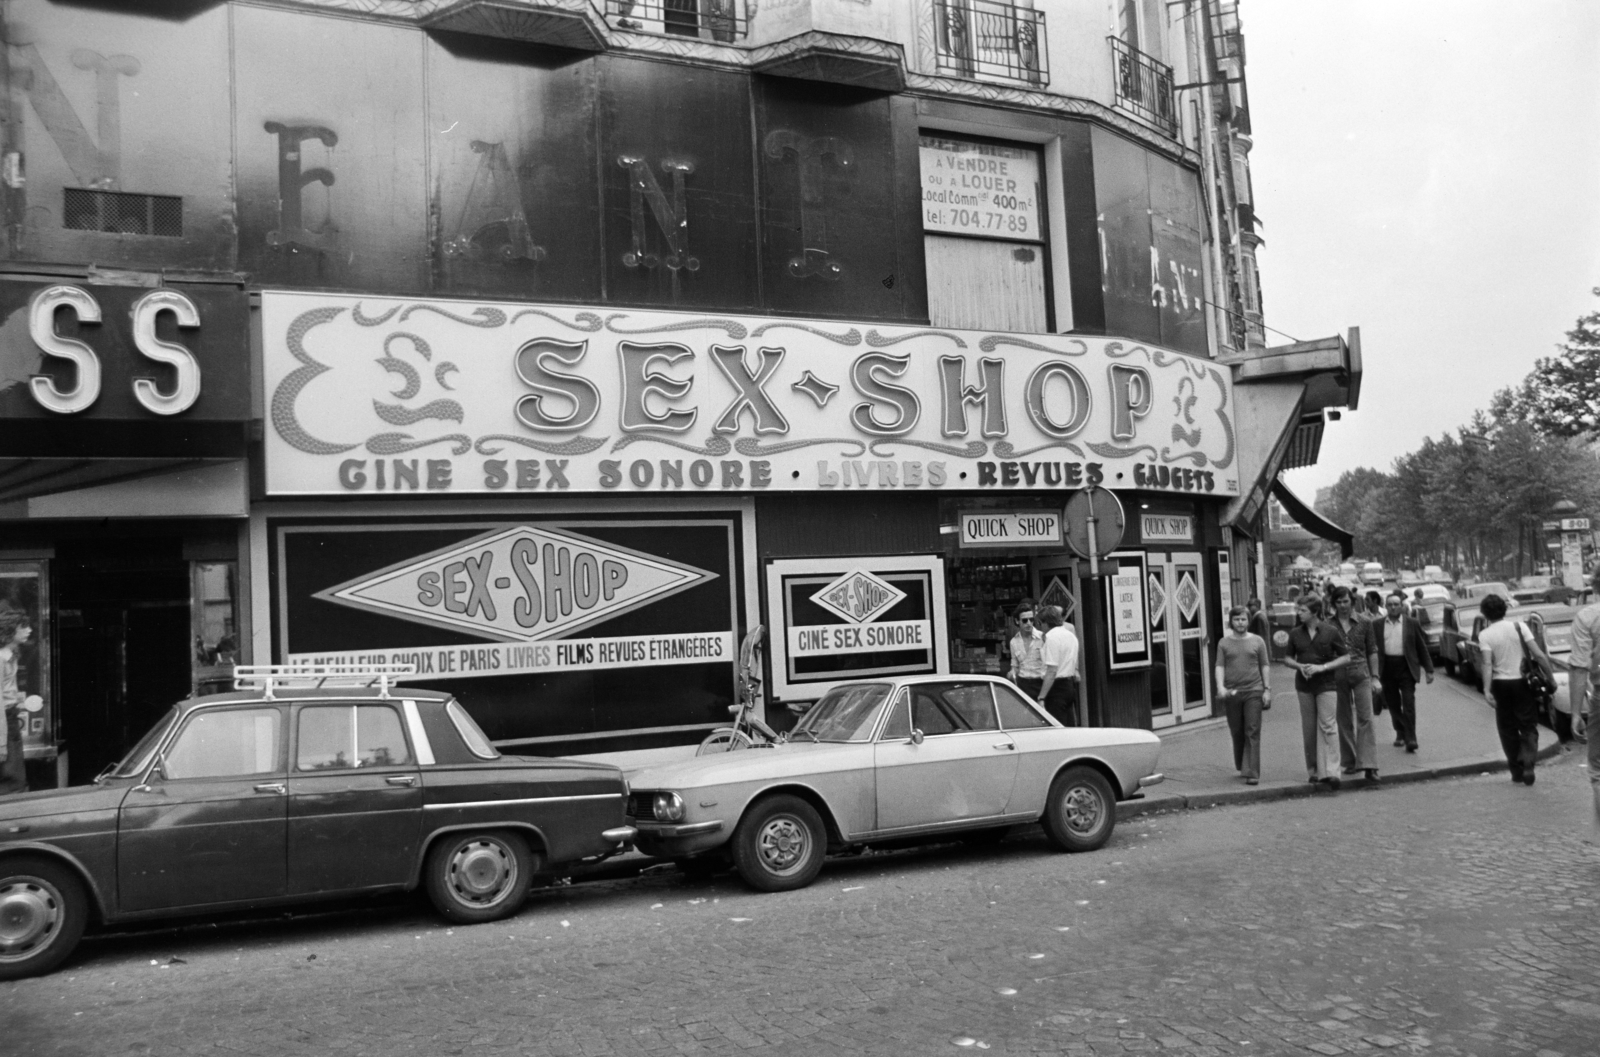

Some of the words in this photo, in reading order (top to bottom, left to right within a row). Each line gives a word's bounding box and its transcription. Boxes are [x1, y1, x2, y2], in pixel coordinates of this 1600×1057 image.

[946, 155, 1008, 176] VENDRE
[961, 174, 1017, 193] LOUER
[483, 459, 570, 489] SEX
[598, 458, 772, 488] SONORE
[817, 460, 948, 488] LIVRES
[977, 461, 1104, 487] REVUES
[1133, 463, 1215, 492] GADGETS
[967, 517, 1009, 539] QUICK
[1018, 517, 1055, 537] SHOP
[1144, 517, 1167, 536] QUICK
[1170, 518, 1188, 535] SHOP
[417, 537, 628, 628] SEX-SHOP
[829, 576, 889, 618] SEX-SHOP
[798, 626, 829, 651] CINÉ
[834, 627, 863, 649] SEX
[867, 624, 922, 646] SONORE
[438, 650, 456, 673] DE
[460, 648, 500, 671] PARIS
[506, 644, 550, 669] LIVRES
[557, 643, 594, 666] FILMS
[599, 640, 646, 663] REVUES
